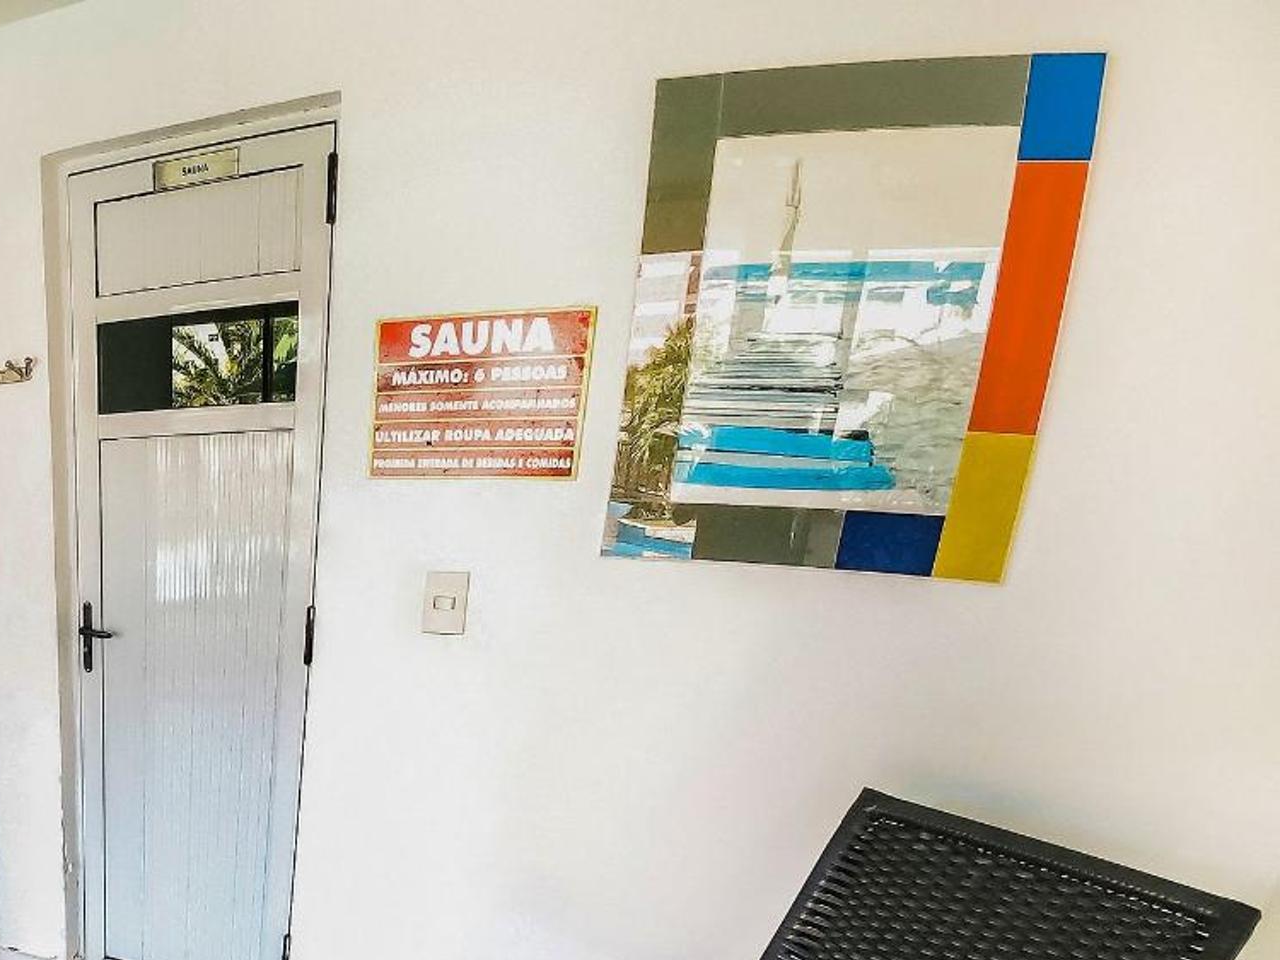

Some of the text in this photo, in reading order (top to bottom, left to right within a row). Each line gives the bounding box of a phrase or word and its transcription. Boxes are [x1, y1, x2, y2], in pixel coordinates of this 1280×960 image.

[182, 163, 209, 177] SAUNA
[409, 317, 556, 357] SAUNA
[393, 365, 567, 386] MÁXIMO: 6 PESSOAS
[379, 402, 428, 413] MENORES
[430, 400, 478, 412] SOMENTE
[445, 429, 491, 442] ROUPA
[494, 427, 574, 441] ADEQUADA
[525, 456, 571, 468] COMIDAS
